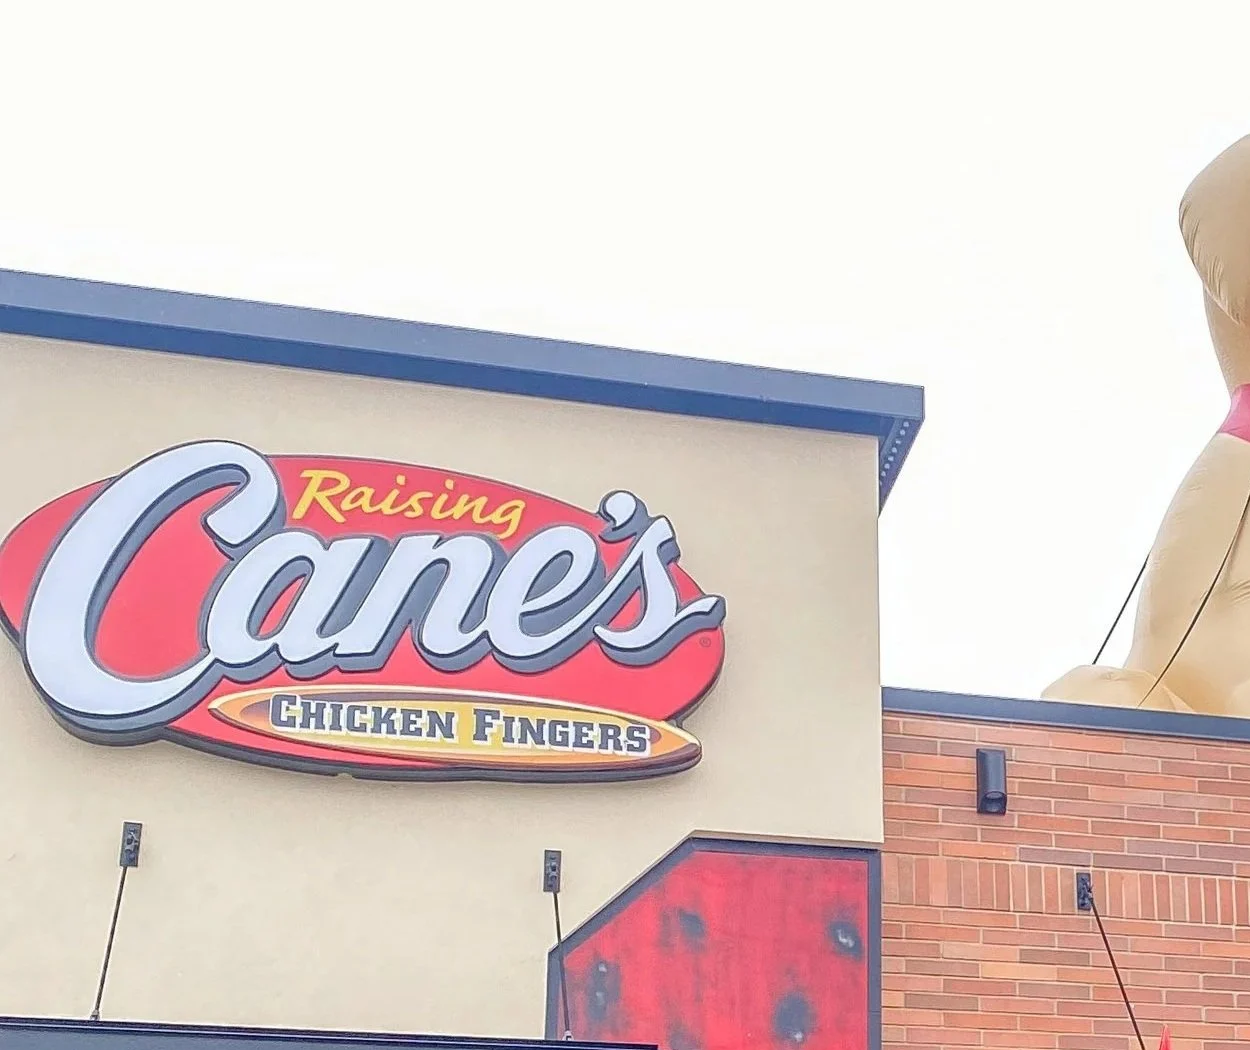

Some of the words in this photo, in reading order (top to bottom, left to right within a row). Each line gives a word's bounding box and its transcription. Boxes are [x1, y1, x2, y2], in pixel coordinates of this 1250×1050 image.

[293, 469, 525, 539] Raising
[24, 439, 725, 722] Cane's
[270, 693, 458, 743] CHICKEN
[473, 708, 652, 757] FINGERS
